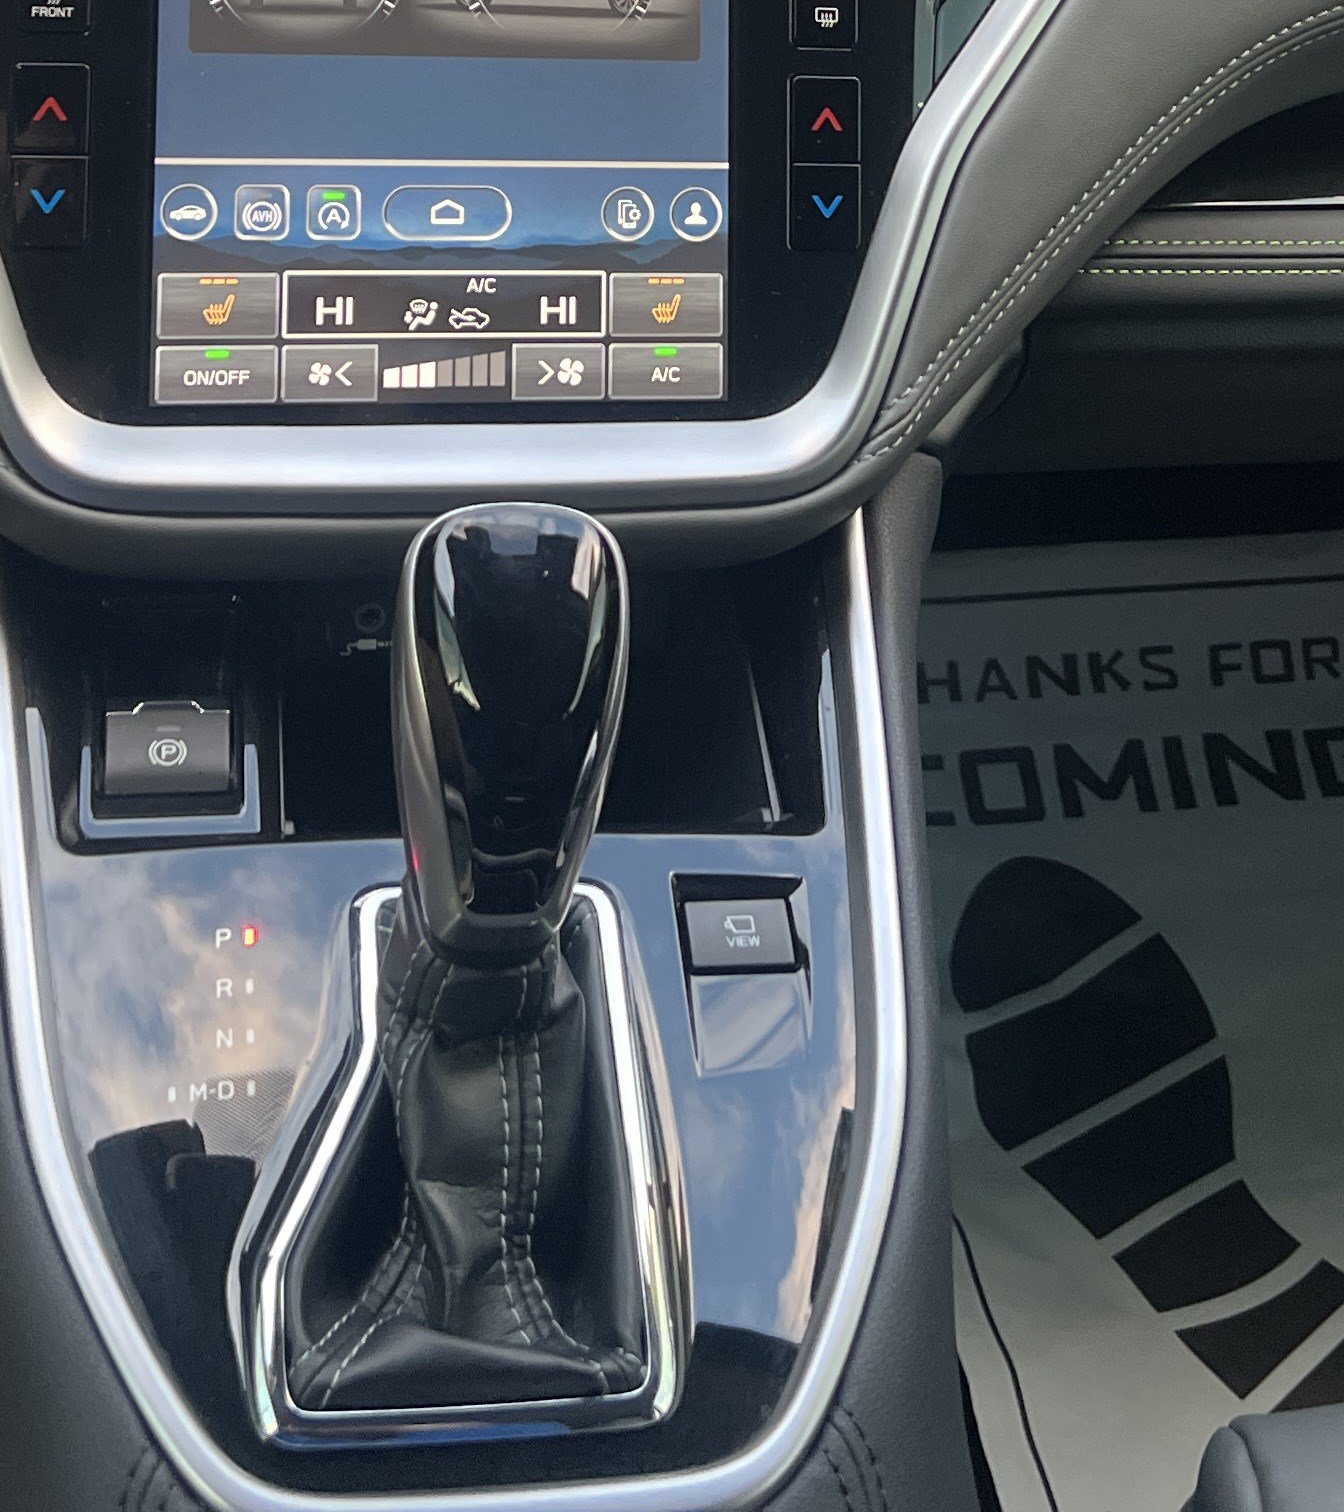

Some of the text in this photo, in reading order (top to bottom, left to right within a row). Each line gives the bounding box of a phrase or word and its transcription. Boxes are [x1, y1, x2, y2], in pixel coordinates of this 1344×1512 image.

[31, 6, 74, 19] FRONT
[252, 208, 274, 223] AVH
[466, 277, 497, 294] A/C
[315, 296, 355, 326] HI
[540, 295, 577, 325] HI
[183, 368, 251, 387] ON/OFF
[651, 366, 682, 383] A/C
[917, 636, 1342, 705] HANKS FOR
[215, 927, 232, 950] P
[725, 934, 761, 948] VIEW
[215, 978, 234, 998] R
[215, 1028, 233, 1049] N
